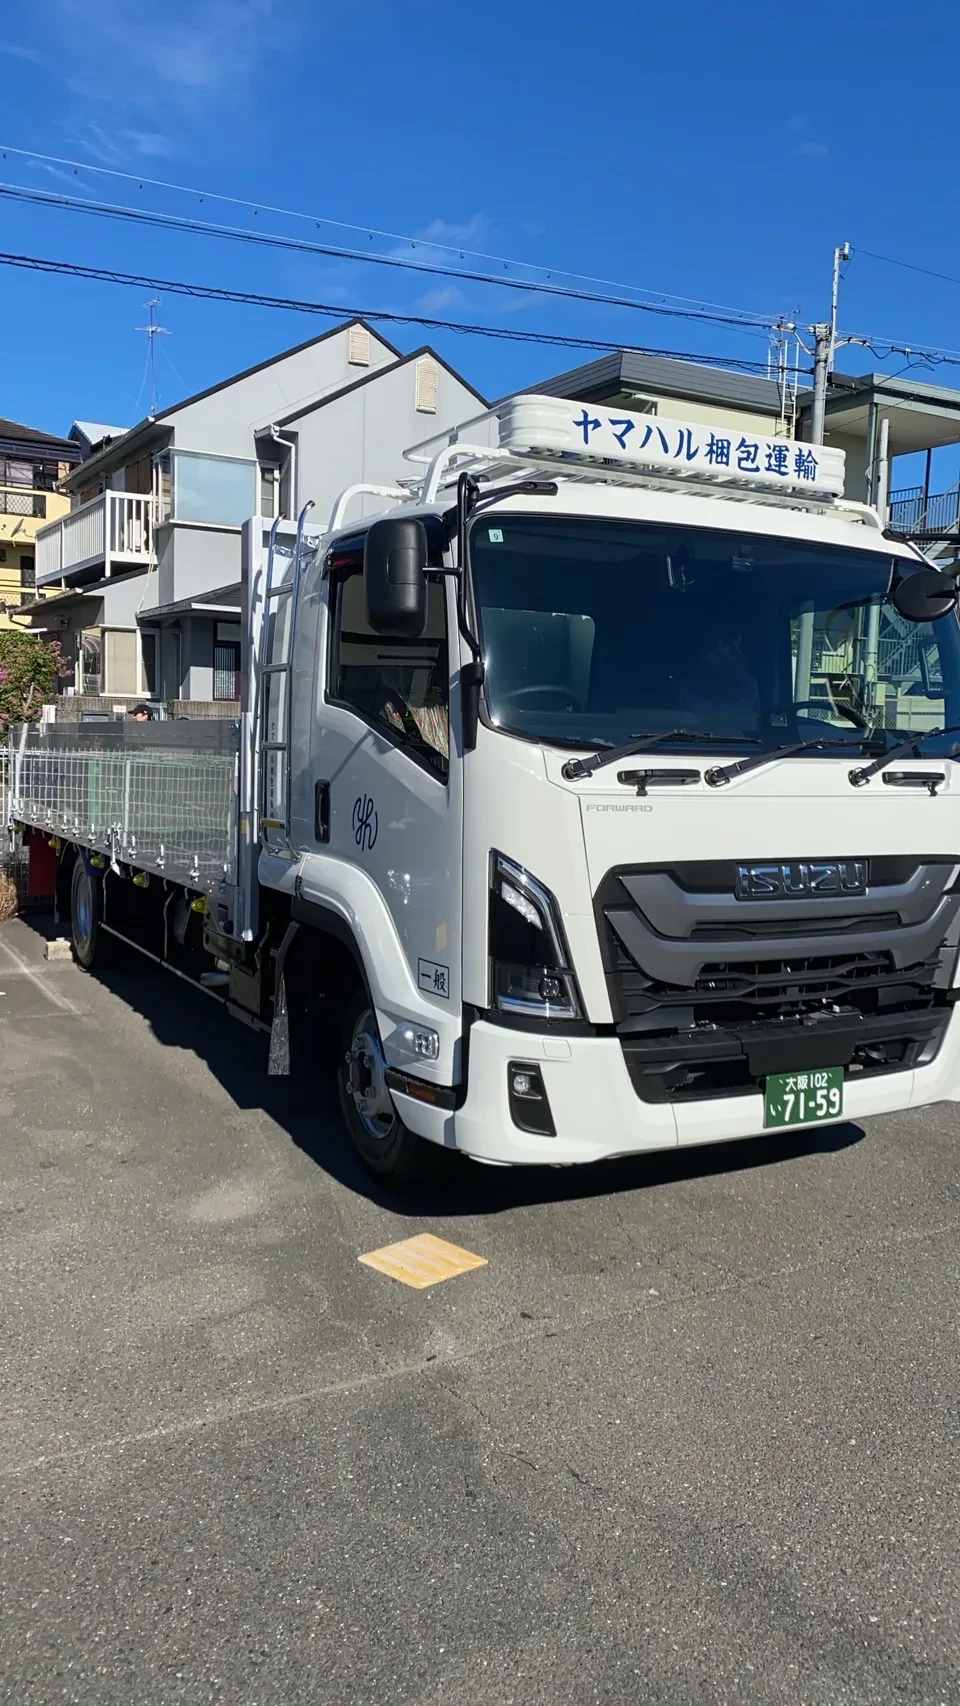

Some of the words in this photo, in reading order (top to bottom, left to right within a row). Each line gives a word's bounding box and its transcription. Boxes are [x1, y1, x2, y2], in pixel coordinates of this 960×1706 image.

[572, 408, 820, 483] ヤマハル梱包運輸
[586, 804, 653, 813] FORWARD
[738, 863, 864, 897] ISUZU
[420, 968, 447, 993] 一般
[785, 1075, 808, 1092] 大阪
[810, 1072, 828, 1089] 102
[783, 1087, 840, 1122] 71-59
